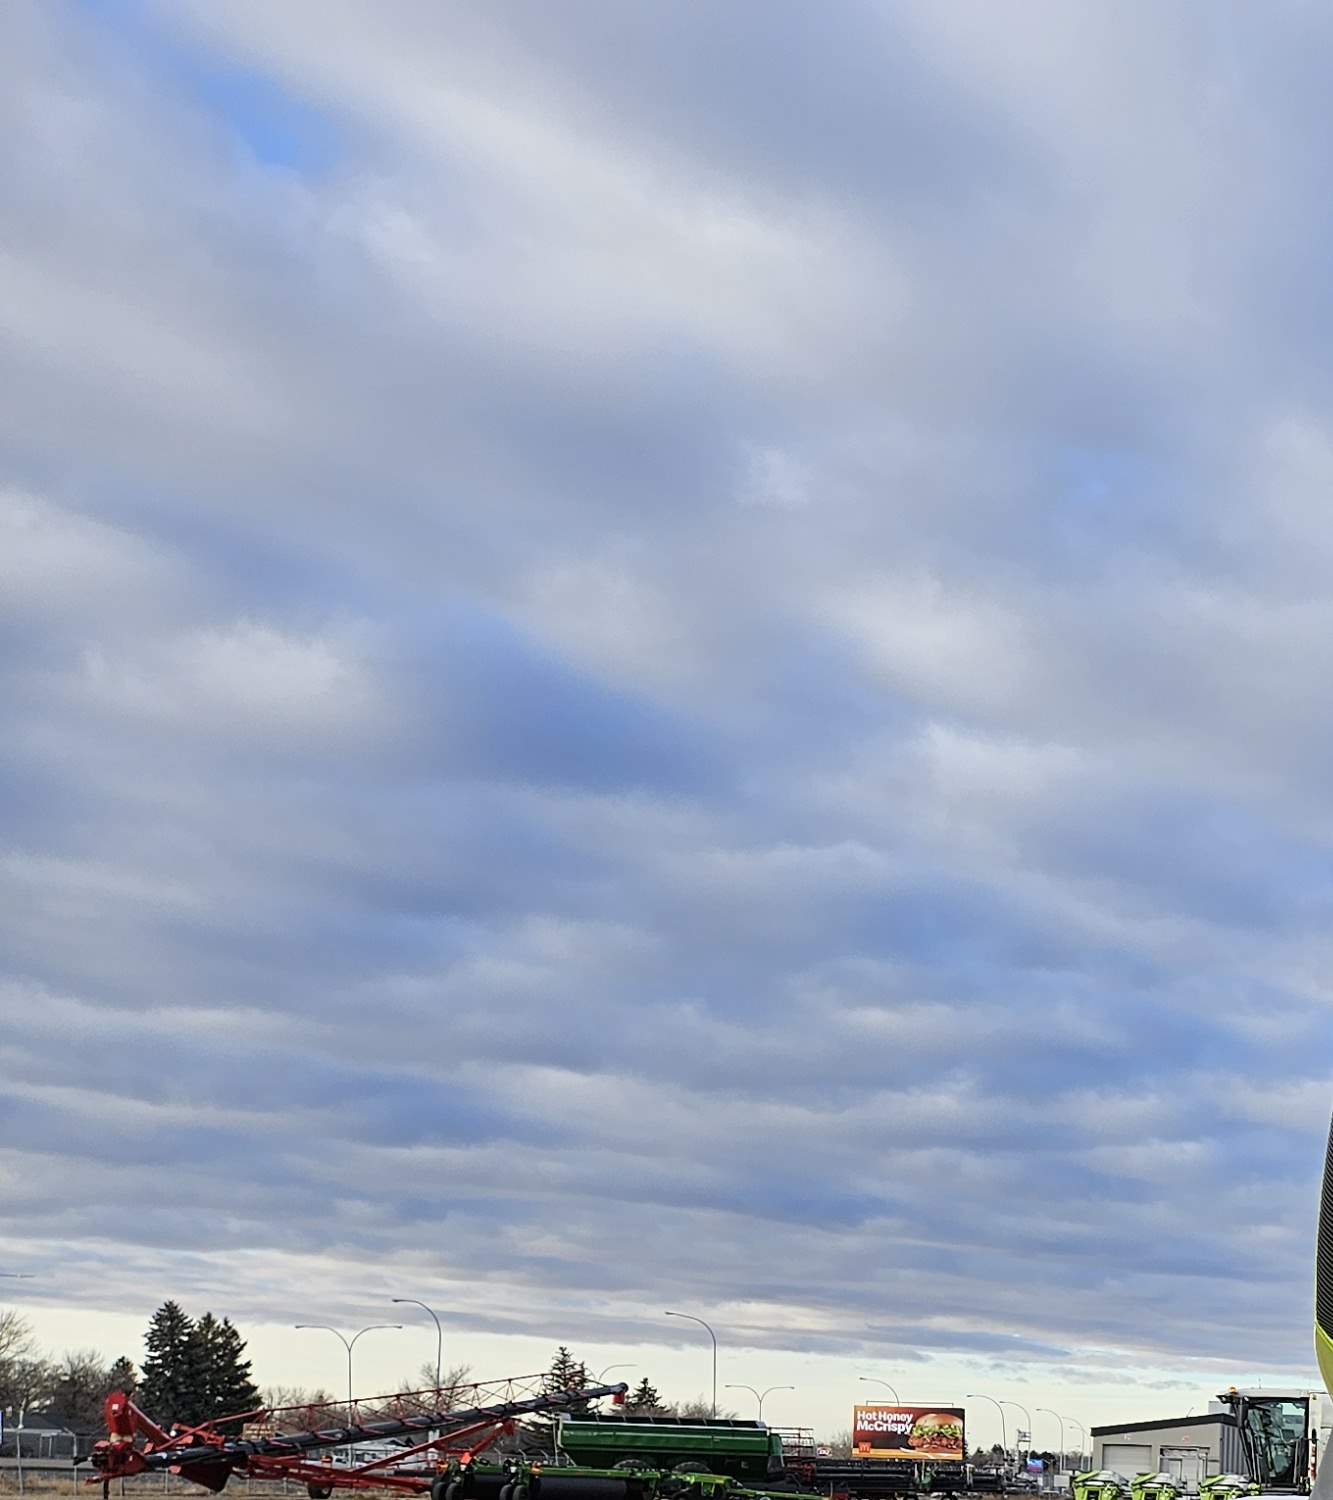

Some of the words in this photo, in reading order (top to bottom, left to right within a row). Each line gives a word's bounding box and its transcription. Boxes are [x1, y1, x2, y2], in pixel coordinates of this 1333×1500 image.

[857, 1411, 877, 1420] Hot
[879, 1411, 913, 1424] Honey
[856, 1421, 913, 1434] McCrispy
